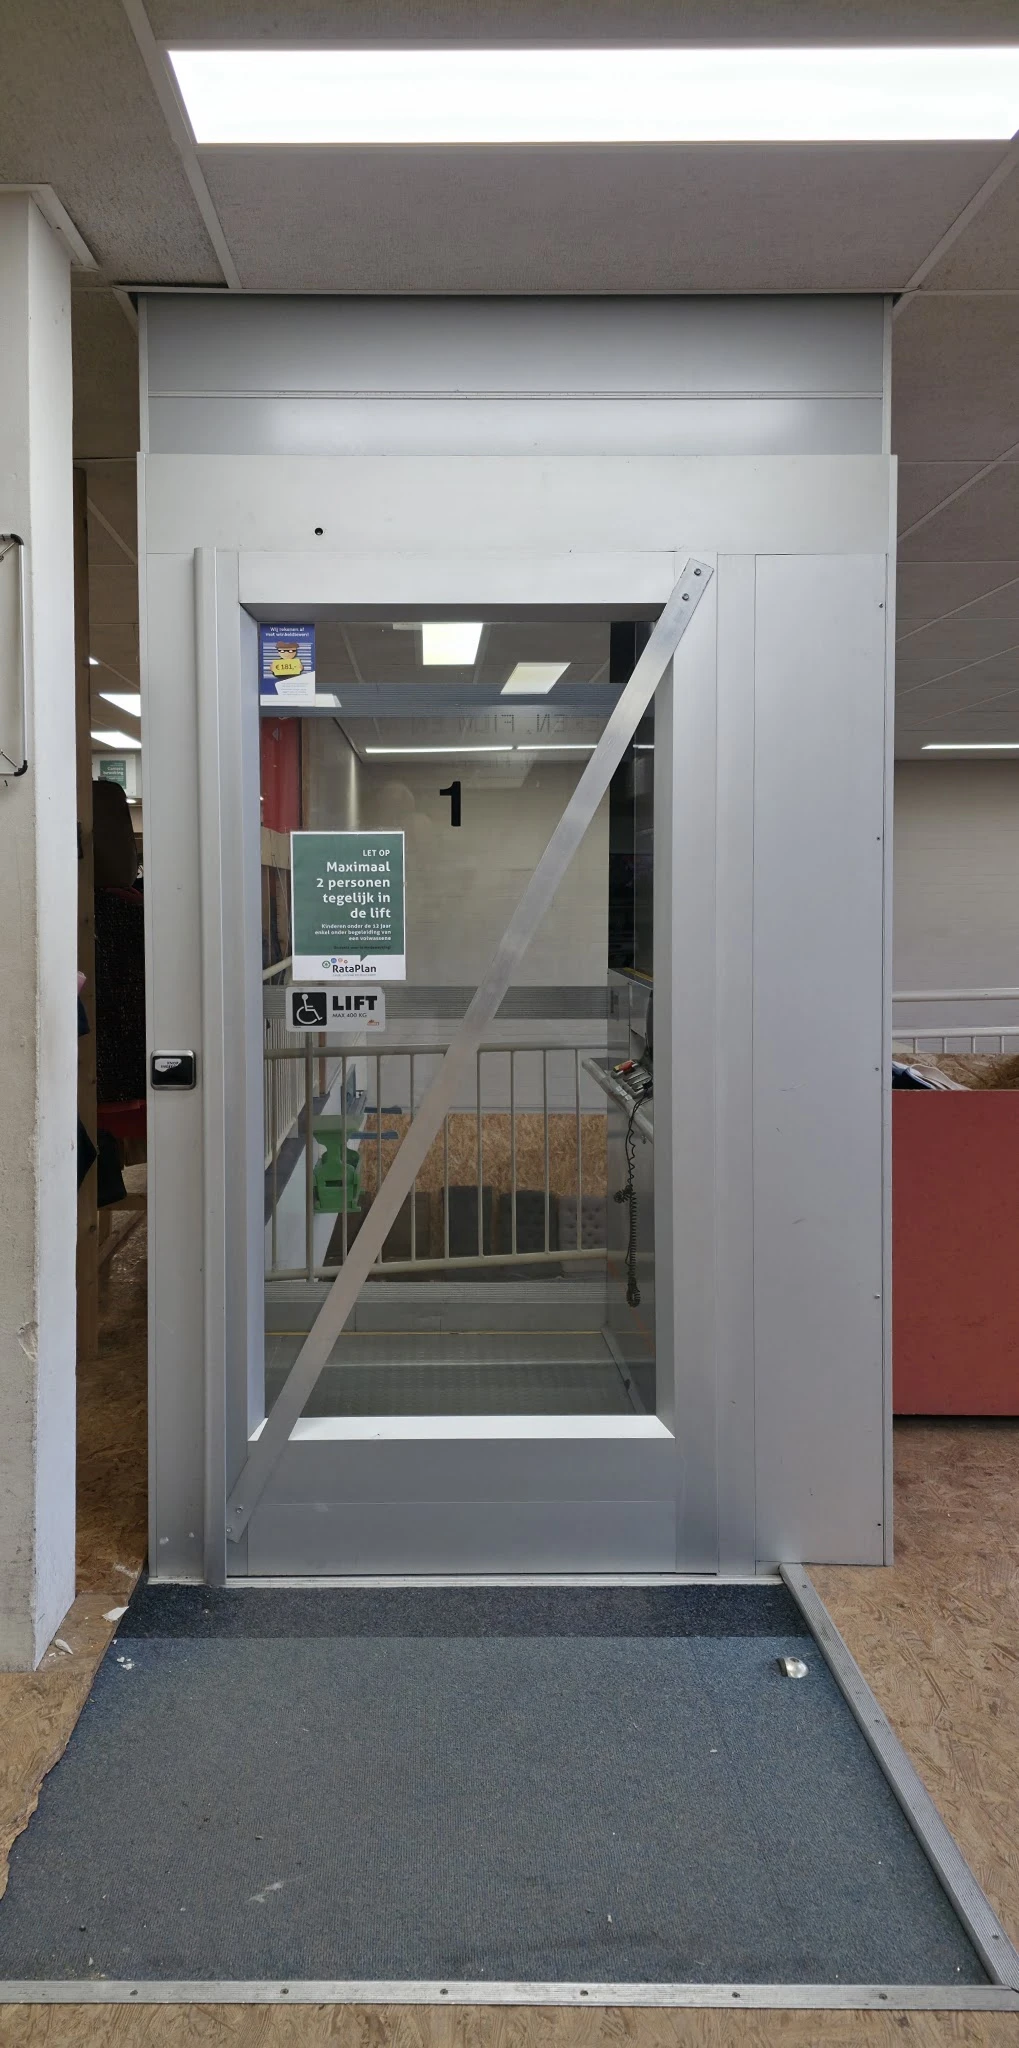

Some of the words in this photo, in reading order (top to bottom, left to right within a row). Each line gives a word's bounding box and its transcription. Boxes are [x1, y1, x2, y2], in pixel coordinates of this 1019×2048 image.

[439, 781, 461, 826] 1
[362, 849, 376, 857] LET
[379, 849, 390, 857] OP
[326, 861, 391, 872] Maximaal
[316, 878, 324, 888] 2
[328, 879, 391, 890] personen
[323, 892, 374, 906] tegelijk
[377, 892, 391, 903] in
[350, 908, 367, 919] de
[370, 908, 391, 919] lift
[332, 964, 376, 973] RataPlan
[332, 995, 378, 1011] LIFT
